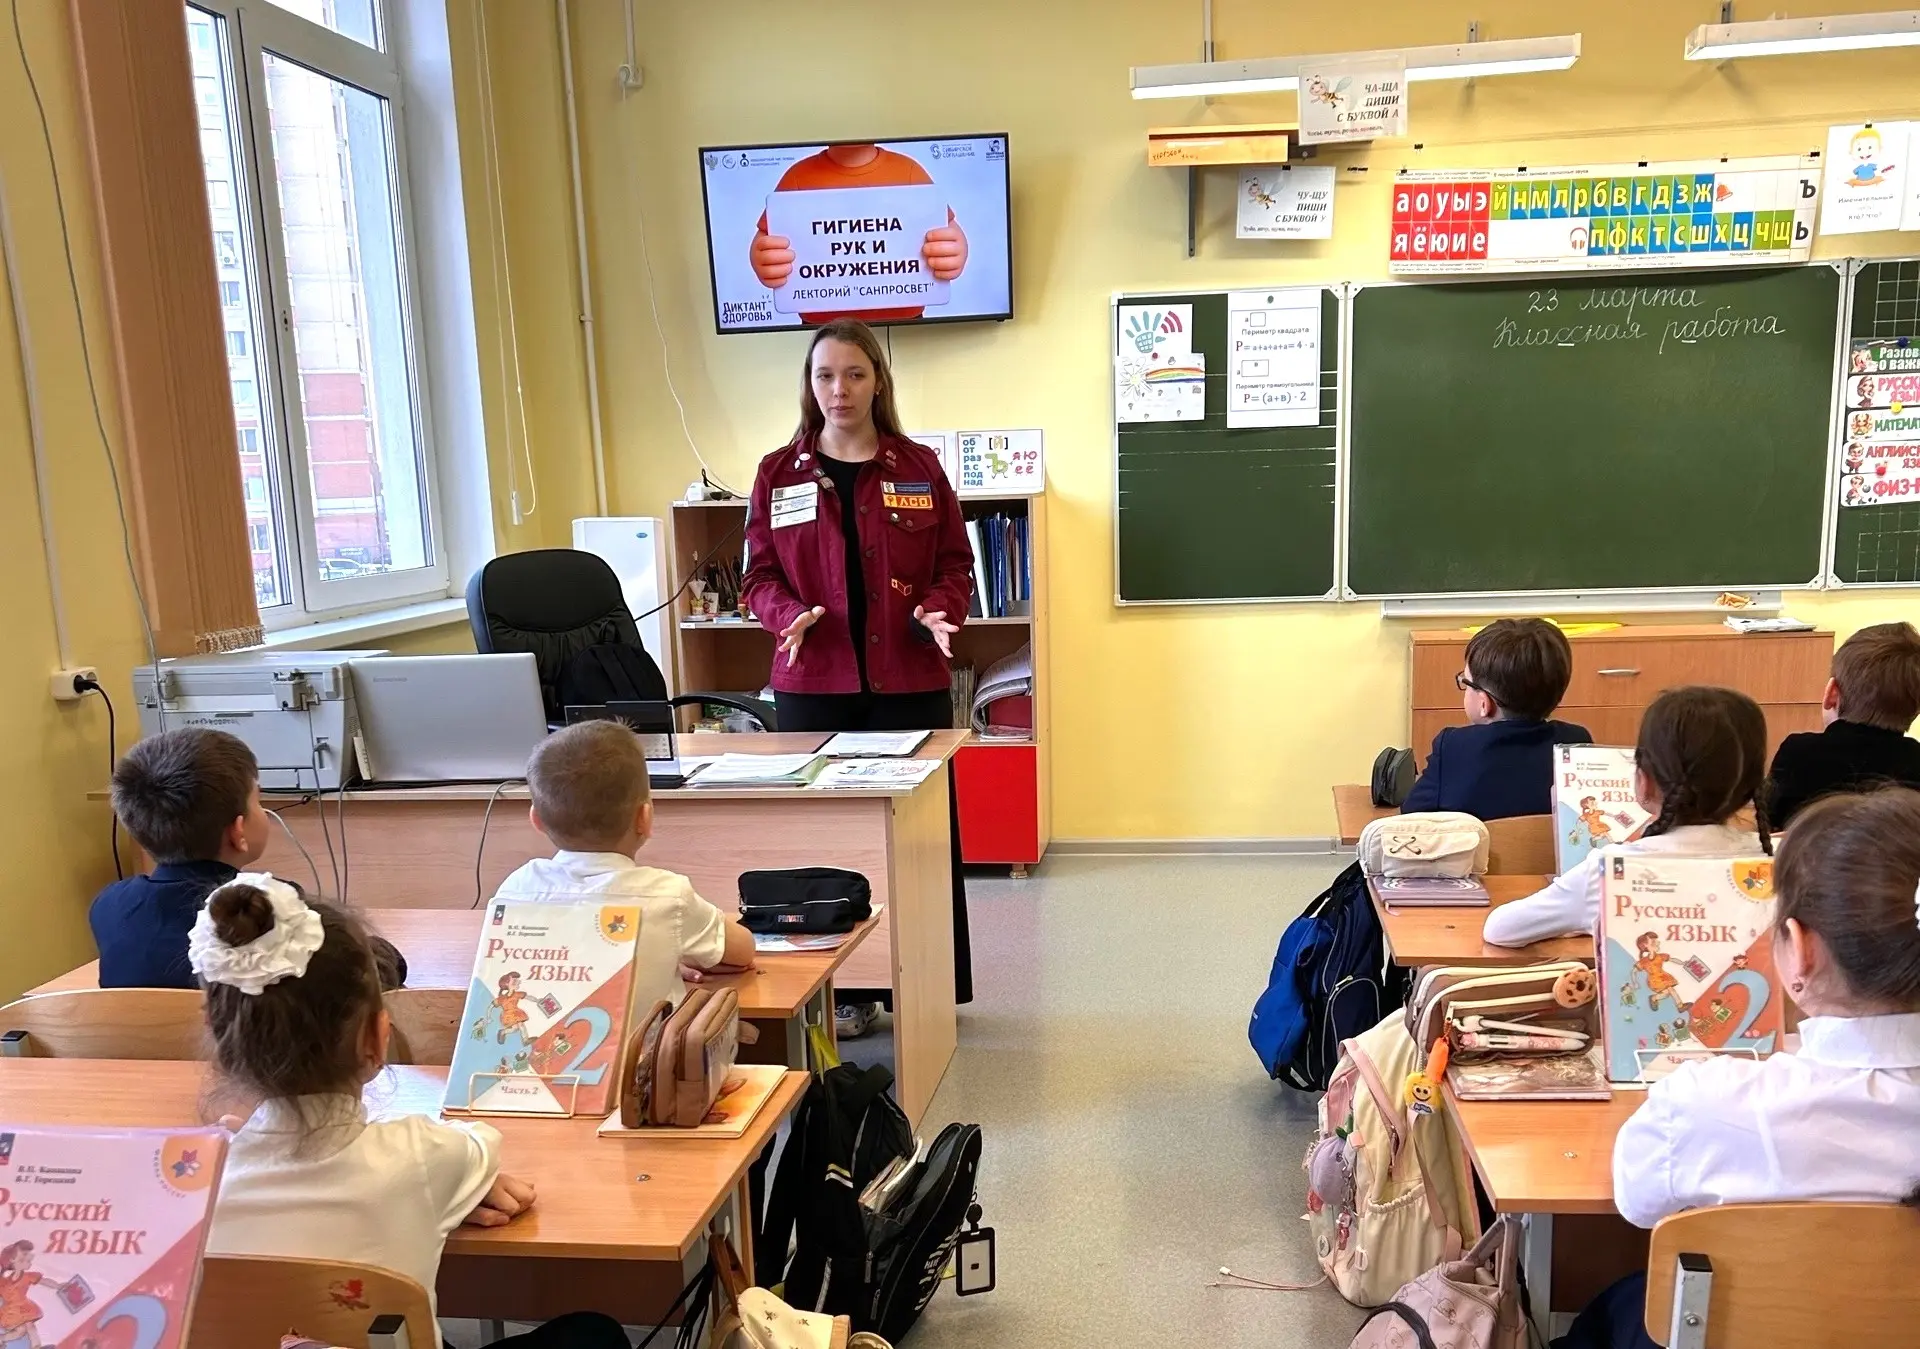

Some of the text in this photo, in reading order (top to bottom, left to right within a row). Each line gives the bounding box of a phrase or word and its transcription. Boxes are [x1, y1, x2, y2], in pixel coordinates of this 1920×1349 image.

[1365, 82, 1398, 93] ЧА-ЩА
[1365, 95, 1400, 107] ПИШИ
[1337, 107, 1399, 122] С БУКВОЙ А
[1298, 191, 1328, 200] ЧУ-ЩУ
[1297, 203, 1327, 212] ПИШИ
[1275, 215, 1281, 223] С
[1282, 213, 1318, 223] БУКВОЙ
[812, 217, 902, 235] ГИГИЕНА
[831, 240, 886, 255] РУК И
[799, 260, 920, 279] ОКРУЖЕНИЯ
[793, 282, 934, 300] ЛЕКТОРИЙ "САНПРОСВЕТ"
[1528, 286, 1706, 324] 23 марта
[722, 311, 772, 324] ЗДОРОВЬЯ
[1241, 327, 1310, 336] Периметр квадрата
[1493, 305, 1786, 355] Классная работа
[963, 437, 976, 446] об
[963, 454, 982, 463] раз
[964, 471, 983, 479] под
[964, 479, 983, 487] над
[1563, 772, 1630, 791] Русский
[1613, 895, 1707, 922] Русский
[1665, 924, 1738, 943] ЯЗЫК
[485, 938, 571, 963] Русский
[526, 965, 594, 982] ЯЗЫК
[1719, 969, 1777, 1055] 2
[552, 1006, 612, 1086] 2
[501, 1085, 530, 1096] Часть
[43, 1229, 147, 1256] ЯЗЫК
